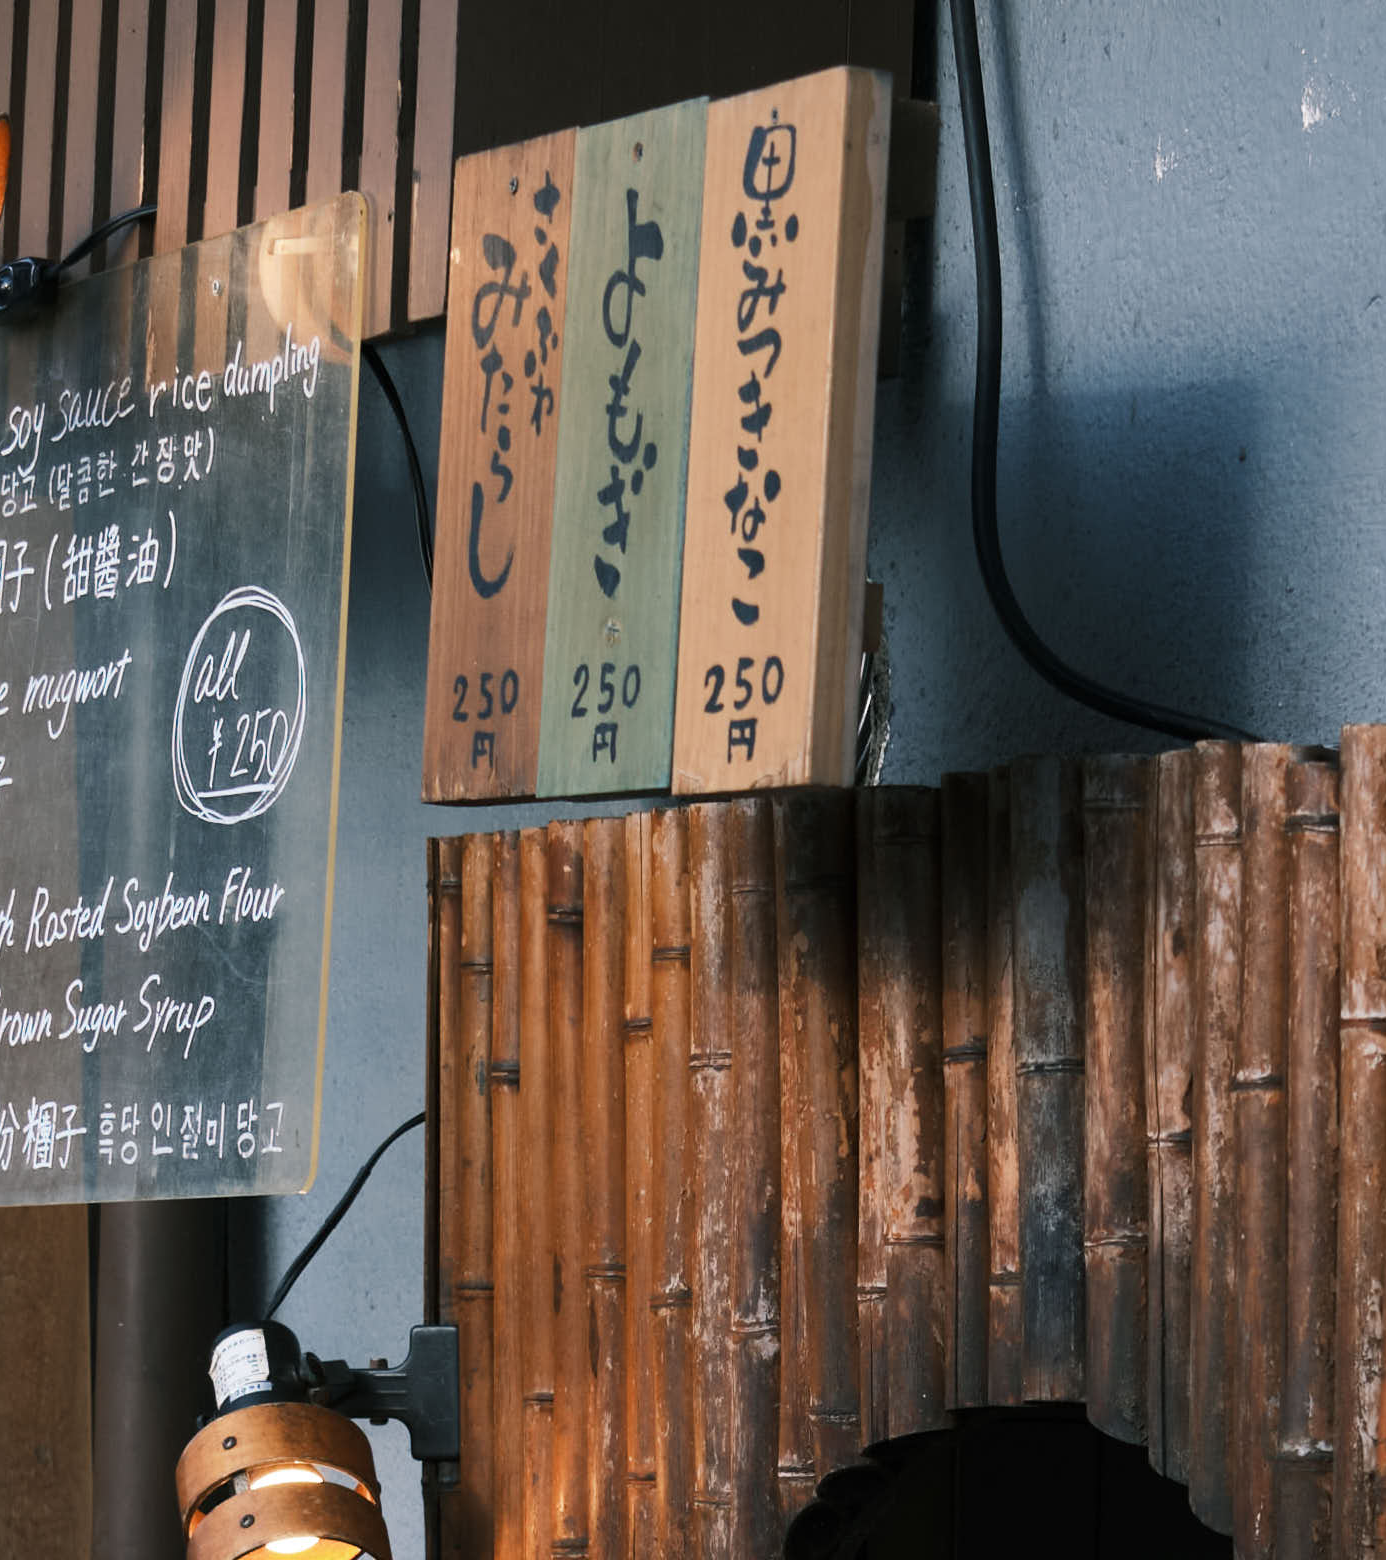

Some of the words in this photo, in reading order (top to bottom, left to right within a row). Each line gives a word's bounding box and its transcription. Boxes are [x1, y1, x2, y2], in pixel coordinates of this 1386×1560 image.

[148, 365, 213, 419] rice
[222, 321, 321, 417] dumpling
[593, 188, 665, 599] よもぎ
[468, 233, 532, 599] みたらし
[22, 647, 133, 740] mugwort
[193, 628, 252, 704] all
[451, 668, 520, 723] 250
[570, 662, 641, 719] 250
[703, 655, 785, 715] 250
[471, 730, 496, 770] 円
[592, 721, 619, 764] 円
[727, 717, 759, 765] 円
[24, 875, 115, 954] Rosted
[115, 871, 211, 952] Soybean
[219, 866, 286, 926] Flour
[58, 978, 127, 1053] Sugar
[133, 973, 215, 1059] Syrup
